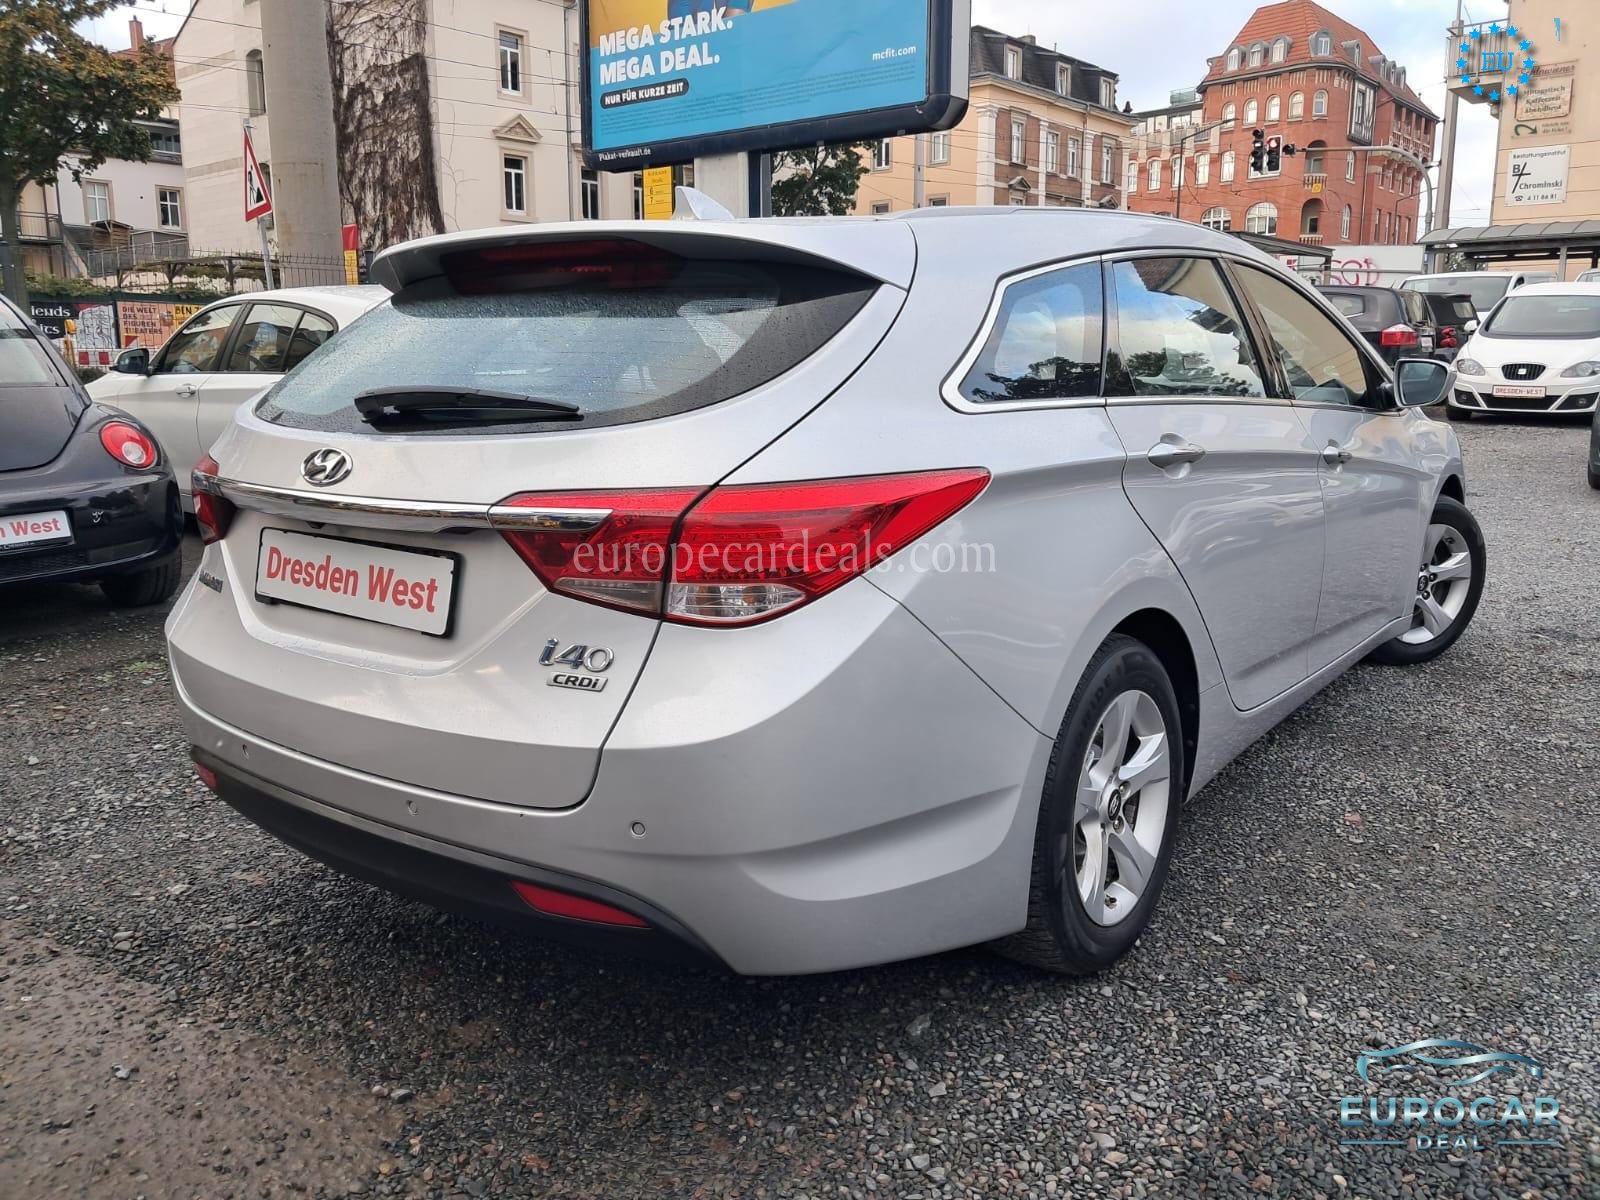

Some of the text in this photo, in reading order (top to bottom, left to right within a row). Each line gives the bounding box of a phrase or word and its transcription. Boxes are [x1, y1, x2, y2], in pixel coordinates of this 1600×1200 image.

[600, 6, 733, 57] MEGA STARK.
[600, 42, 720, 86] MEGA DEAL.
[872, 46, 917, 61] mcfit.com
[604, 82, 684, 105] NUR FÜR KURZE ZEIT
[1512, 164, 1521, 174] B
[1519, 179, 1562, 189] Chrominski
[9, 517, 62, 537] West
[266, 546, 359, 597] Dresden
[368, 564, 438, 613] West
[539, 637, 615, 673] i40
[553, 674, 600, 689] CRDi
